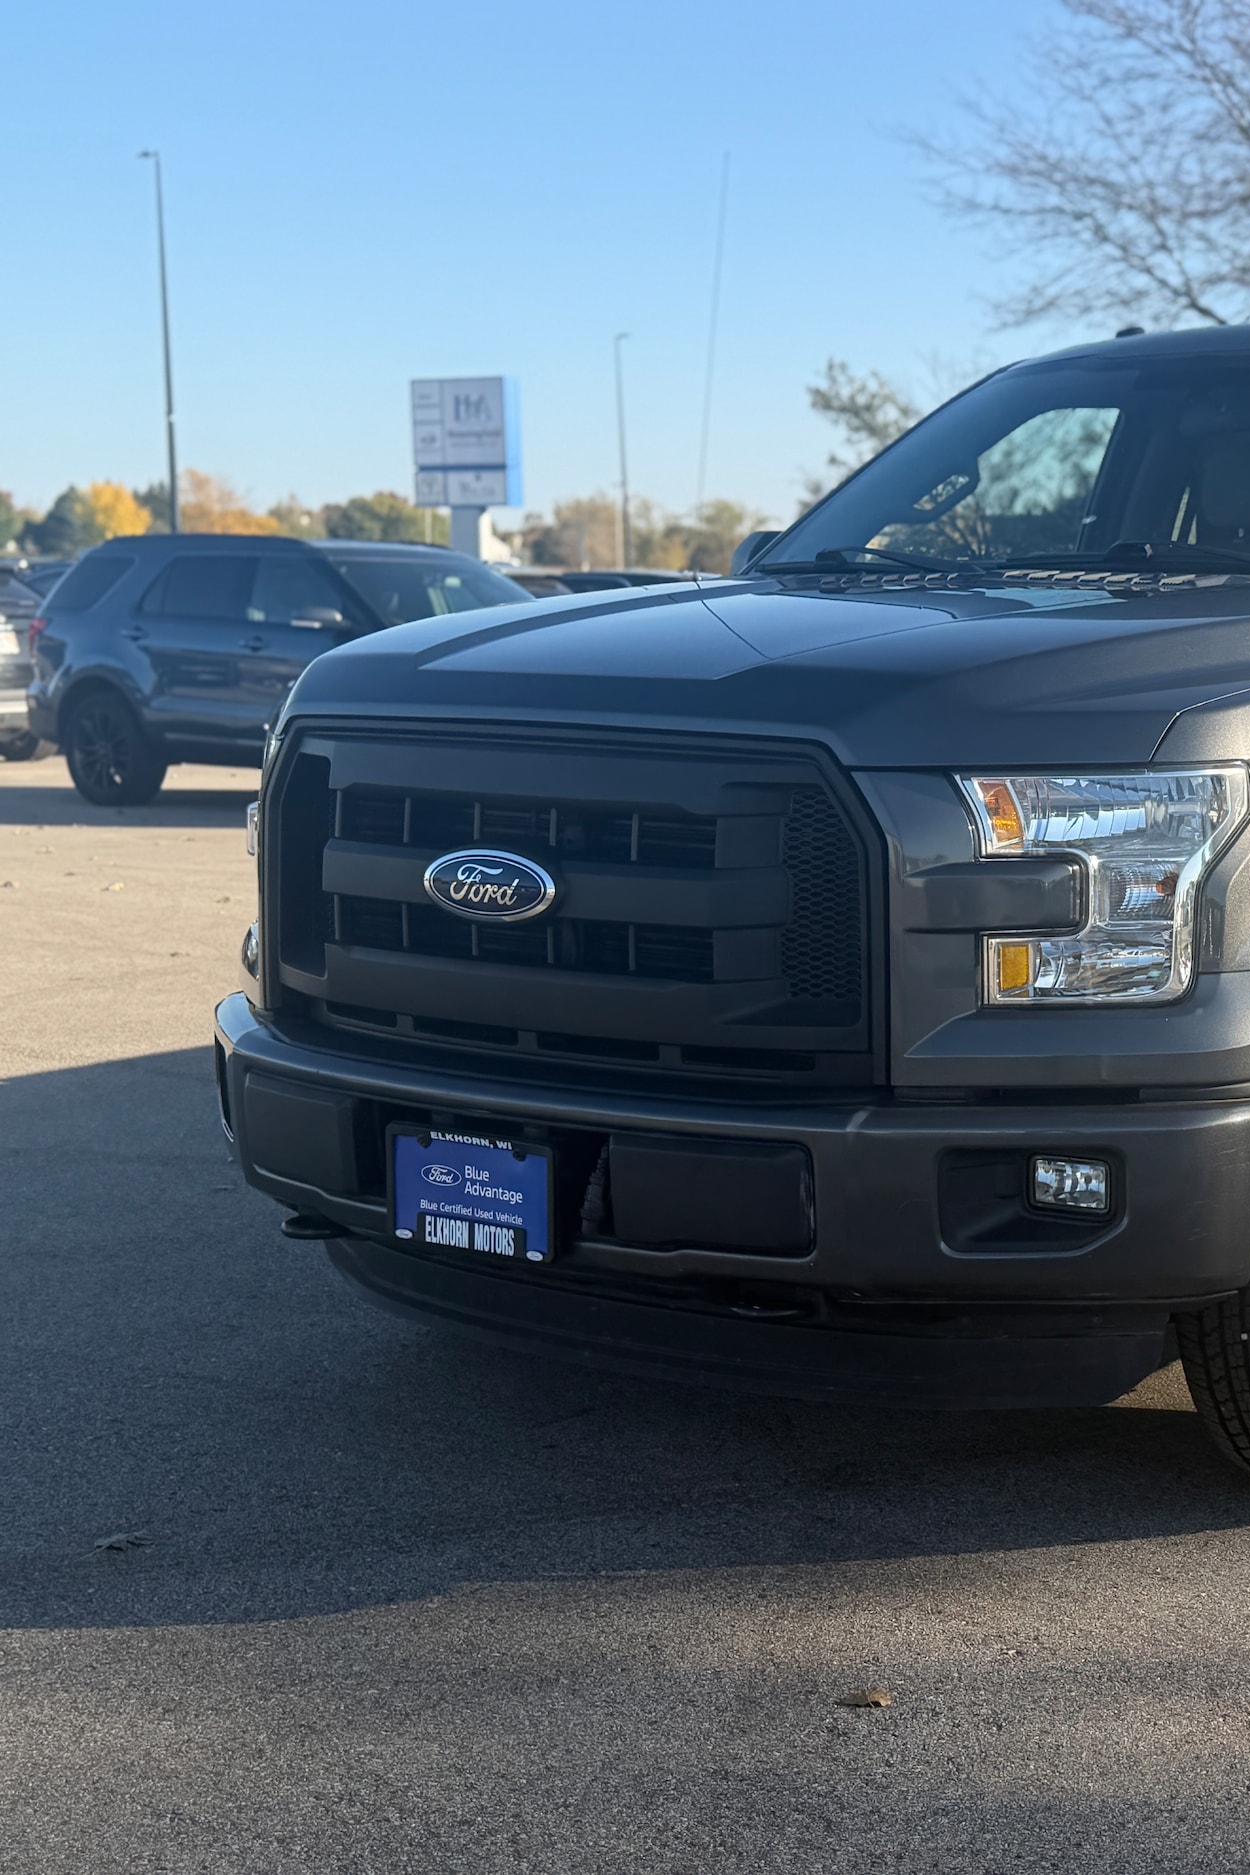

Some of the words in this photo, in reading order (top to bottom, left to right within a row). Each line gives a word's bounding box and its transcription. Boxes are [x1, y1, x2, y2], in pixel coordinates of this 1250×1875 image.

[450, 863, 519, 905] Ford
[430, 1131, 494, 1149] ELKHORN,
[496, 1140, 513, 1150] WI
[428, 1166, 454, 1184] Ford
[464, 1165, 490, 1181] Blue
[464, 1181, 523, 1204] Advantage
[420, 1199, 438, 1210] Blue
[440, 1202, 472, 1216] Certified
[474, 1208, 494, 1220] Used
[495, 1212, 523, 1225] Vehicle
[425, 1215, 470, 1249] ELKHORN
[474, 1223, 515, 1257] MOTORS
